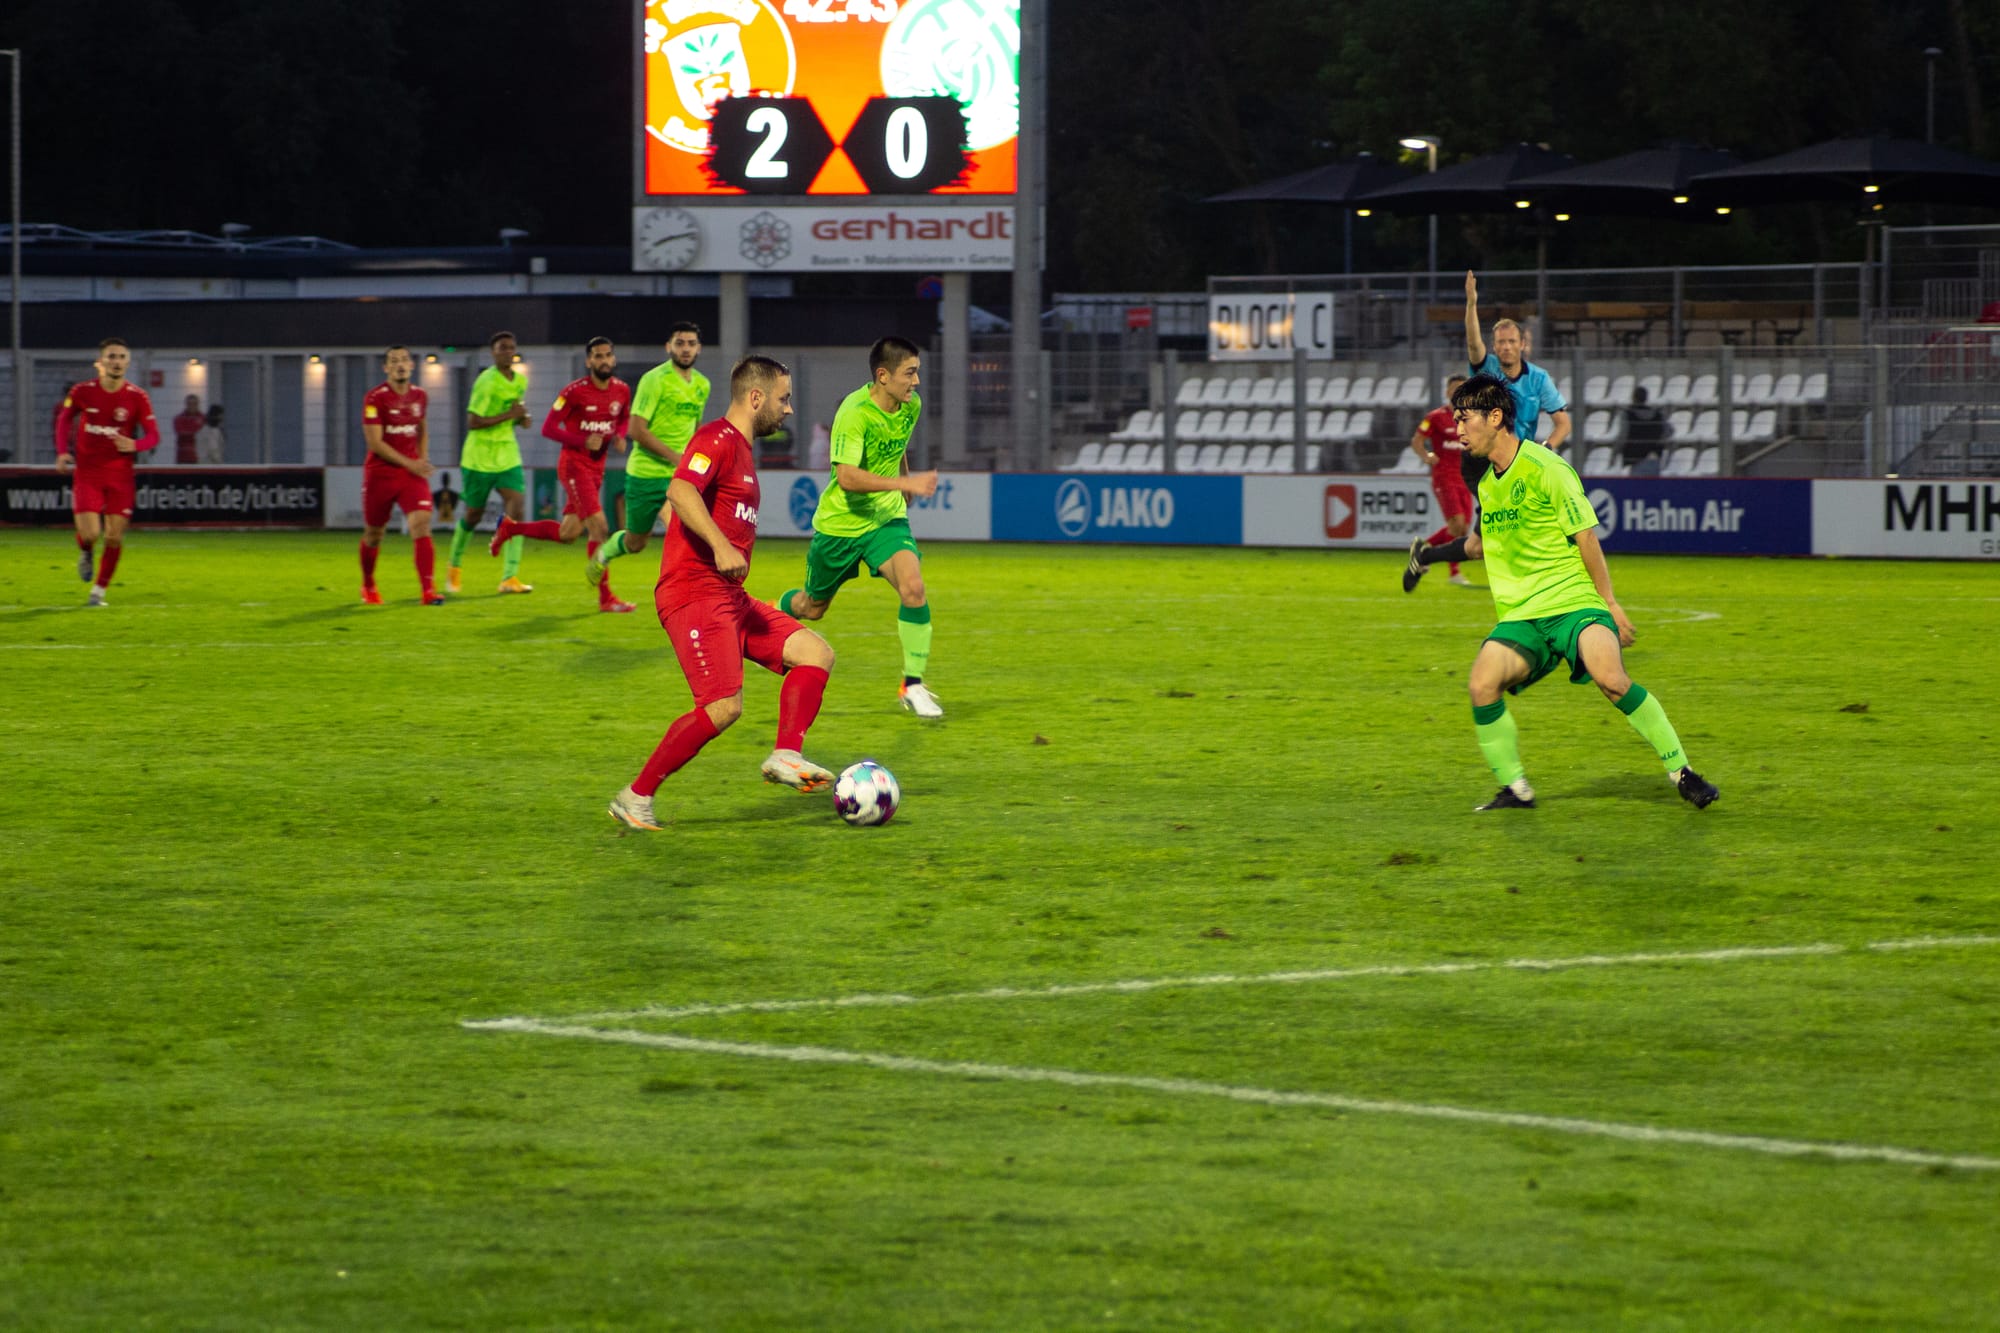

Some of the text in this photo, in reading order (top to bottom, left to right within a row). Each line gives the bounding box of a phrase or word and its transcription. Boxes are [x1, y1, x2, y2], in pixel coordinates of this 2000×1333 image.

[744, 106, 789, 178] 2
[885, 106, 928, 178] 0
[1311, 304, 1326, 349] C
[1096, 488, 1174, 528] JAKO
[1361, 491, 1428, 515] RADIO
[1623, 499, 1745, 532] Hahn Air
